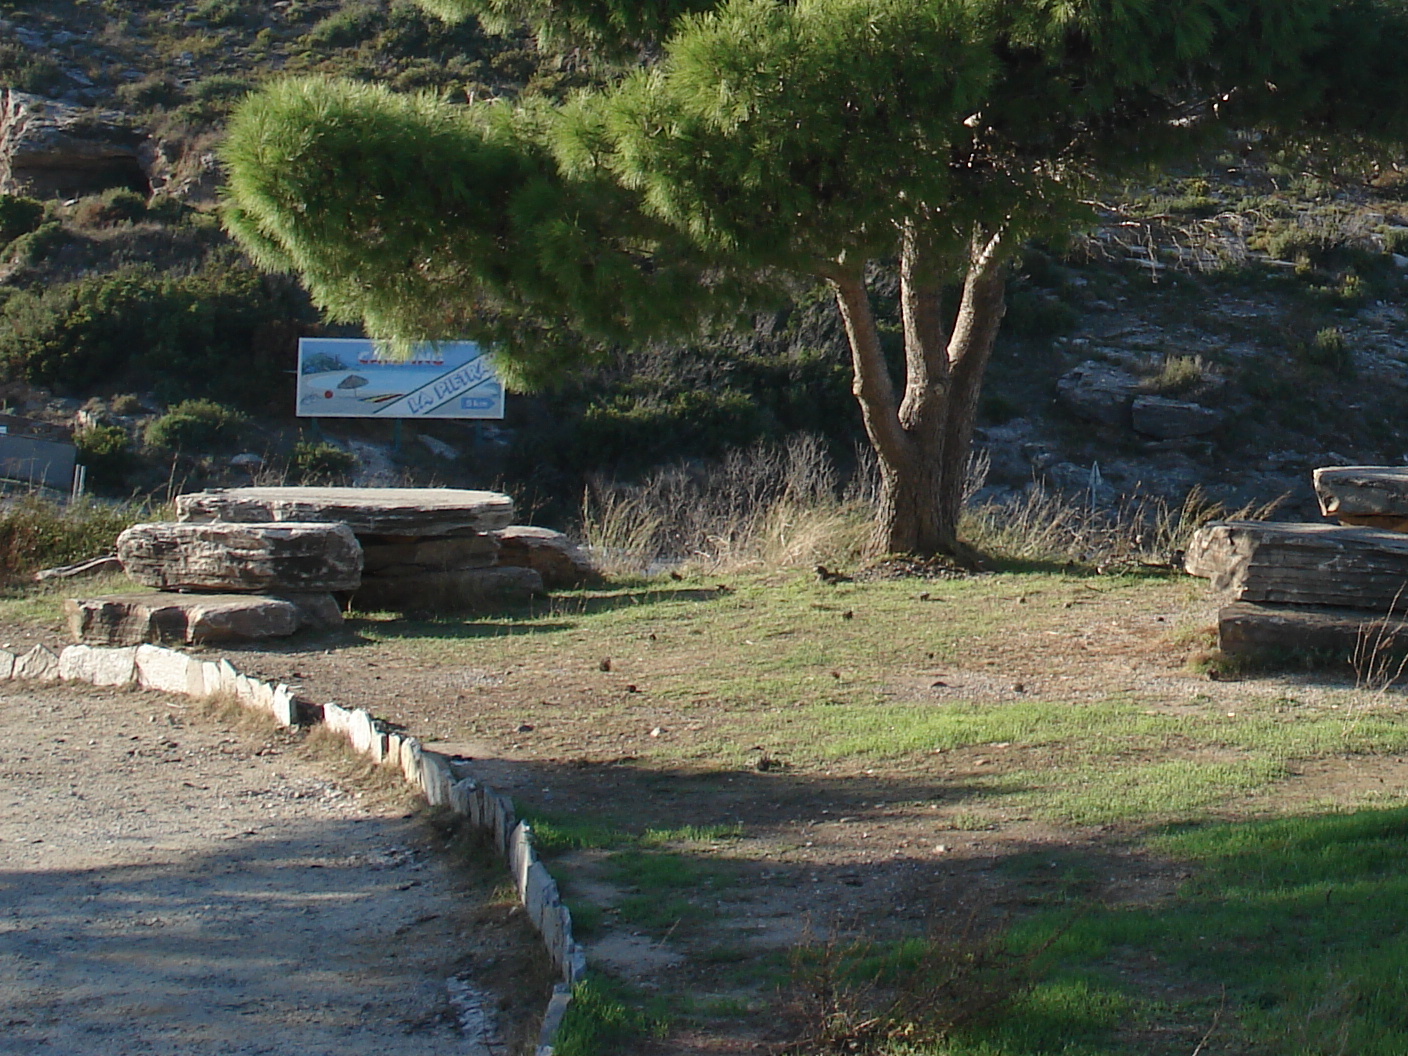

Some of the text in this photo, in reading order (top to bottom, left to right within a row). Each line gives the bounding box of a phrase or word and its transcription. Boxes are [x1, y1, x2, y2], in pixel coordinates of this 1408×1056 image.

[358, 351, 444, 365] CAING
[407, 359, 491, 414] LA PIETRA
[473, 399, 488, 407] km
